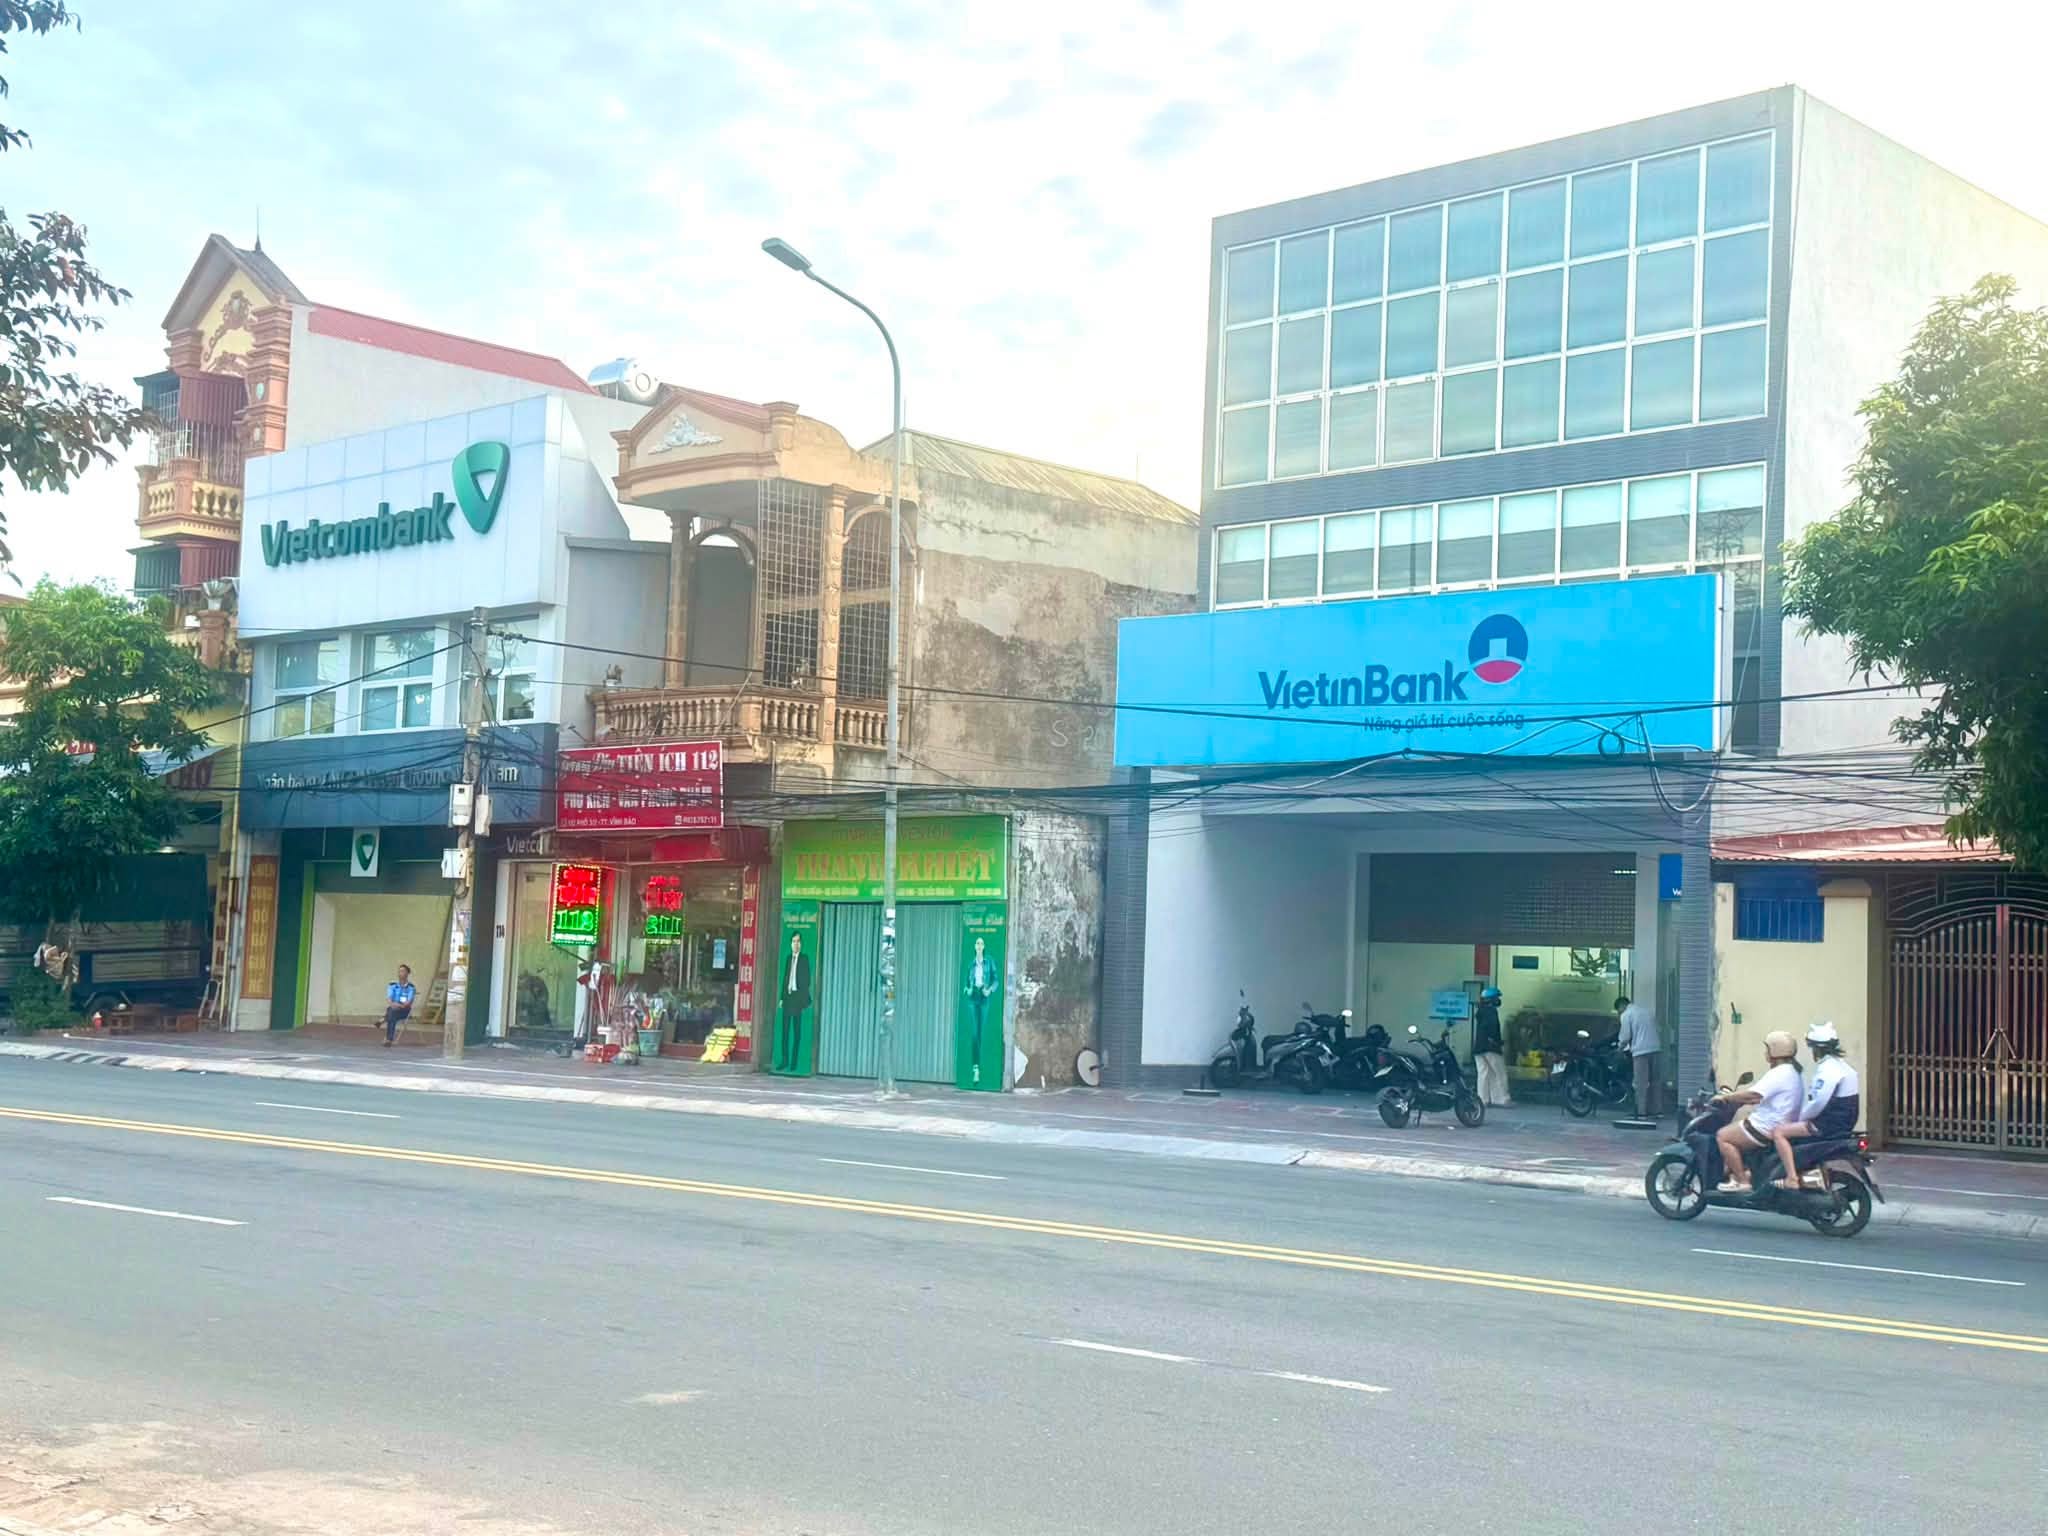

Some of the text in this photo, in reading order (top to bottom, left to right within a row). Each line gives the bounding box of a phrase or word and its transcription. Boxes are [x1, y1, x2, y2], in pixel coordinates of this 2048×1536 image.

[261, 492, 456, 567] Vietcombank
[1258, 660, 1470, 710] VietinBank
[1405, 714, 1429, 732] giá
[1448, 712, 1485, 731] cuộc
[1488, 711, 1525, 730] sống
[659, 745, 687, 773] ÍCH
[692, 749, 719, 771] 112
